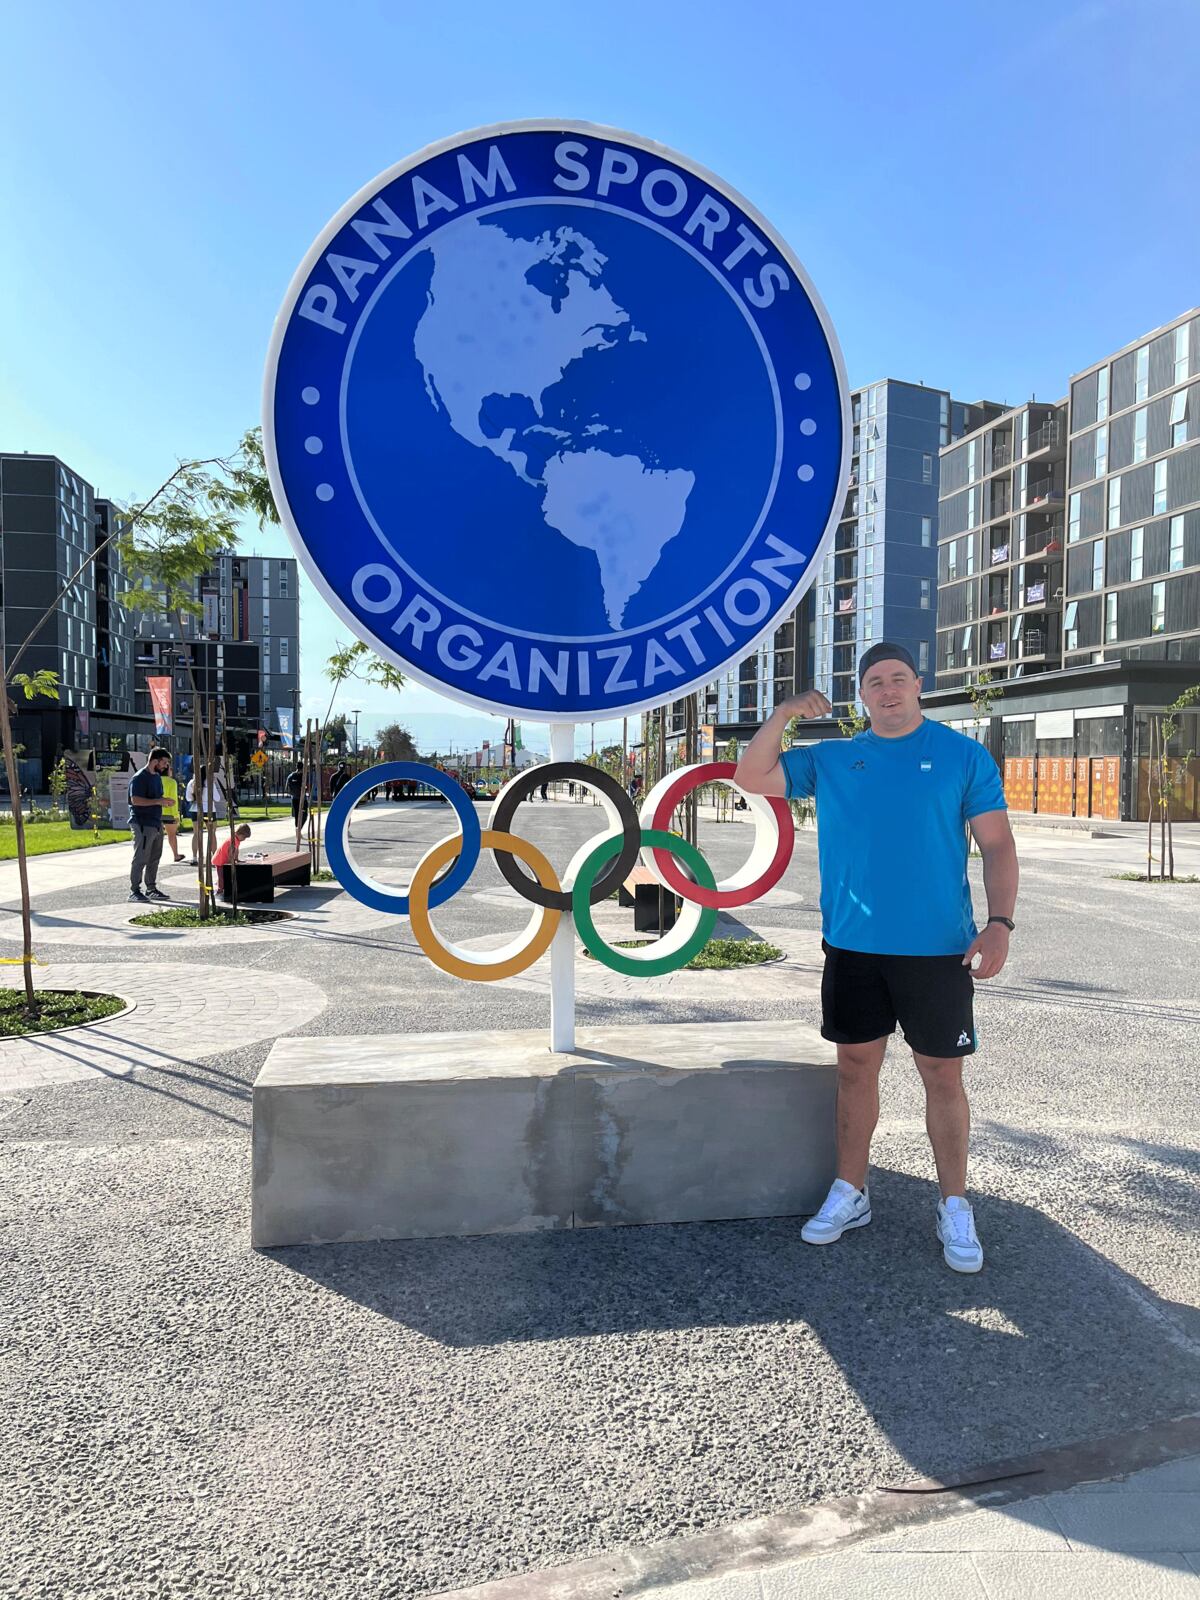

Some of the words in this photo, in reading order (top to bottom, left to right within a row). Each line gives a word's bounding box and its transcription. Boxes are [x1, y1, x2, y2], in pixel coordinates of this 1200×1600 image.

[298, 144, 517, 335] PANAM
[553, 141, 790, 309] SPORTS
[351, 533, 807, 696] ORGANIZATION
